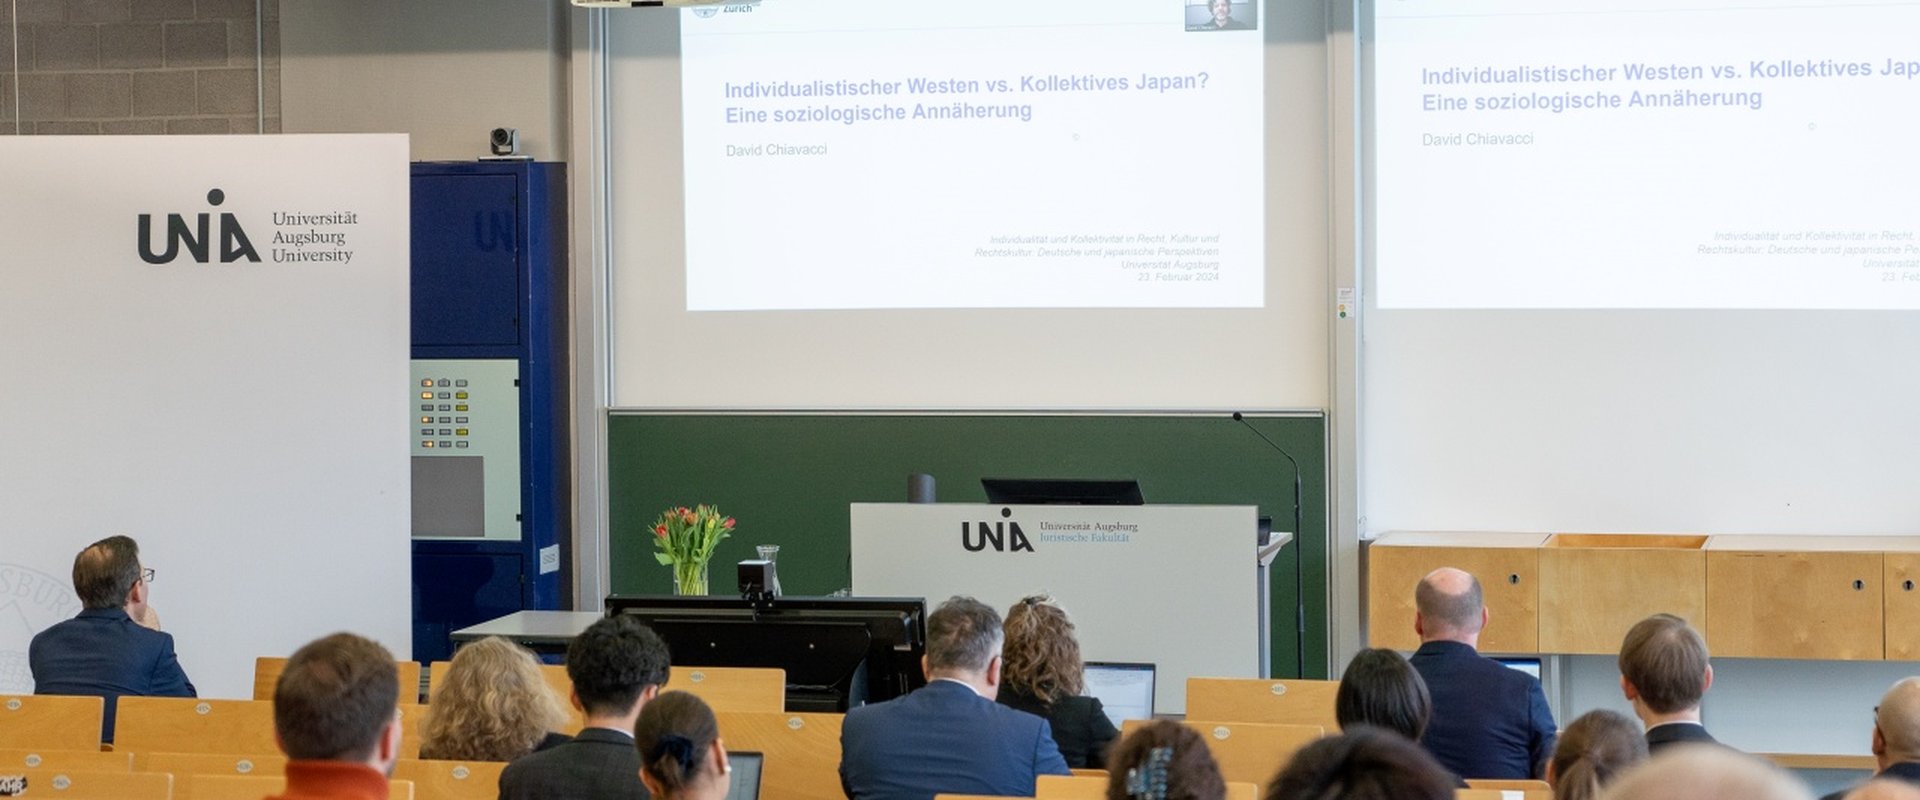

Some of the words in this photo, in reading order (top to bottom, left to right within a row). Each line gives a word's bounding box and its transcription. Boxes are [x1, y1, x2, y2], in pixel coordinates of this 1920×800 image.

[1422, 64, 1617, 85] Individualistischer
[1623, 62, 1703, 81] Westen
[1710, 62, 1742, 79] vs.
[1750, 59, 1873, 78] Kollektives
[1879, 57, 1920, 80] Jap
[725, 79, 902, 99] Individualistischer
[907, 77, 979, 95] Westen
[985, 78, 1014, 94] vs.
[1020, 74, 1129, 93] Kollektives
[1135, 71, 1210, 94] Japan?
[1422, 93, 1468, 112] Eine
[1474, 90, 1622, 113] soziologische
[1628, 88, 1763, 111] Annäherung
[725, 107, 768, 124] Eine
[773, 103, 907, 125] soziologische
[911, 101, 1032, 123] Annäherung
[1422, 132, 1462, 147] David
[1465, 131, 1534, 147] Chiavacci
[726, 143, 763, 157] David
[765, 143, 828, 157] Chiavacci
[272, 210, 358, 226] Universität
[272, 228, 346, 247] Augsburg
[1050, 234, 1069, 244] und
[1170, 234, 1199, 244] Kultur
[1200, 234, 1219, 244] und
[1782, 231, 1803, 241] und
[272, 248, 353, 265] University
[1038, 246, 1082, 257] Deutsche
[1084, 247, 1102, 257] und
[1157, 246, 1219, 258] Perspektiven
[1768, 244, 1818, 255] Deutsche
[1820, 244, 1841, 255] und
[1842, 244, 1901, 257] japanische
[1121, 259, 1171, 270] Universität
[1172, 259, 1219, 271] Augsburg
[1156, 271, 1193, 282] Februar
[1195, 271, 1219, 282] 2024
[1040, 521, 1091, 531] Universität
[1094, 521, 1139, 533] Augsburg
[1091, 532, 1130, 543] Fakultät
